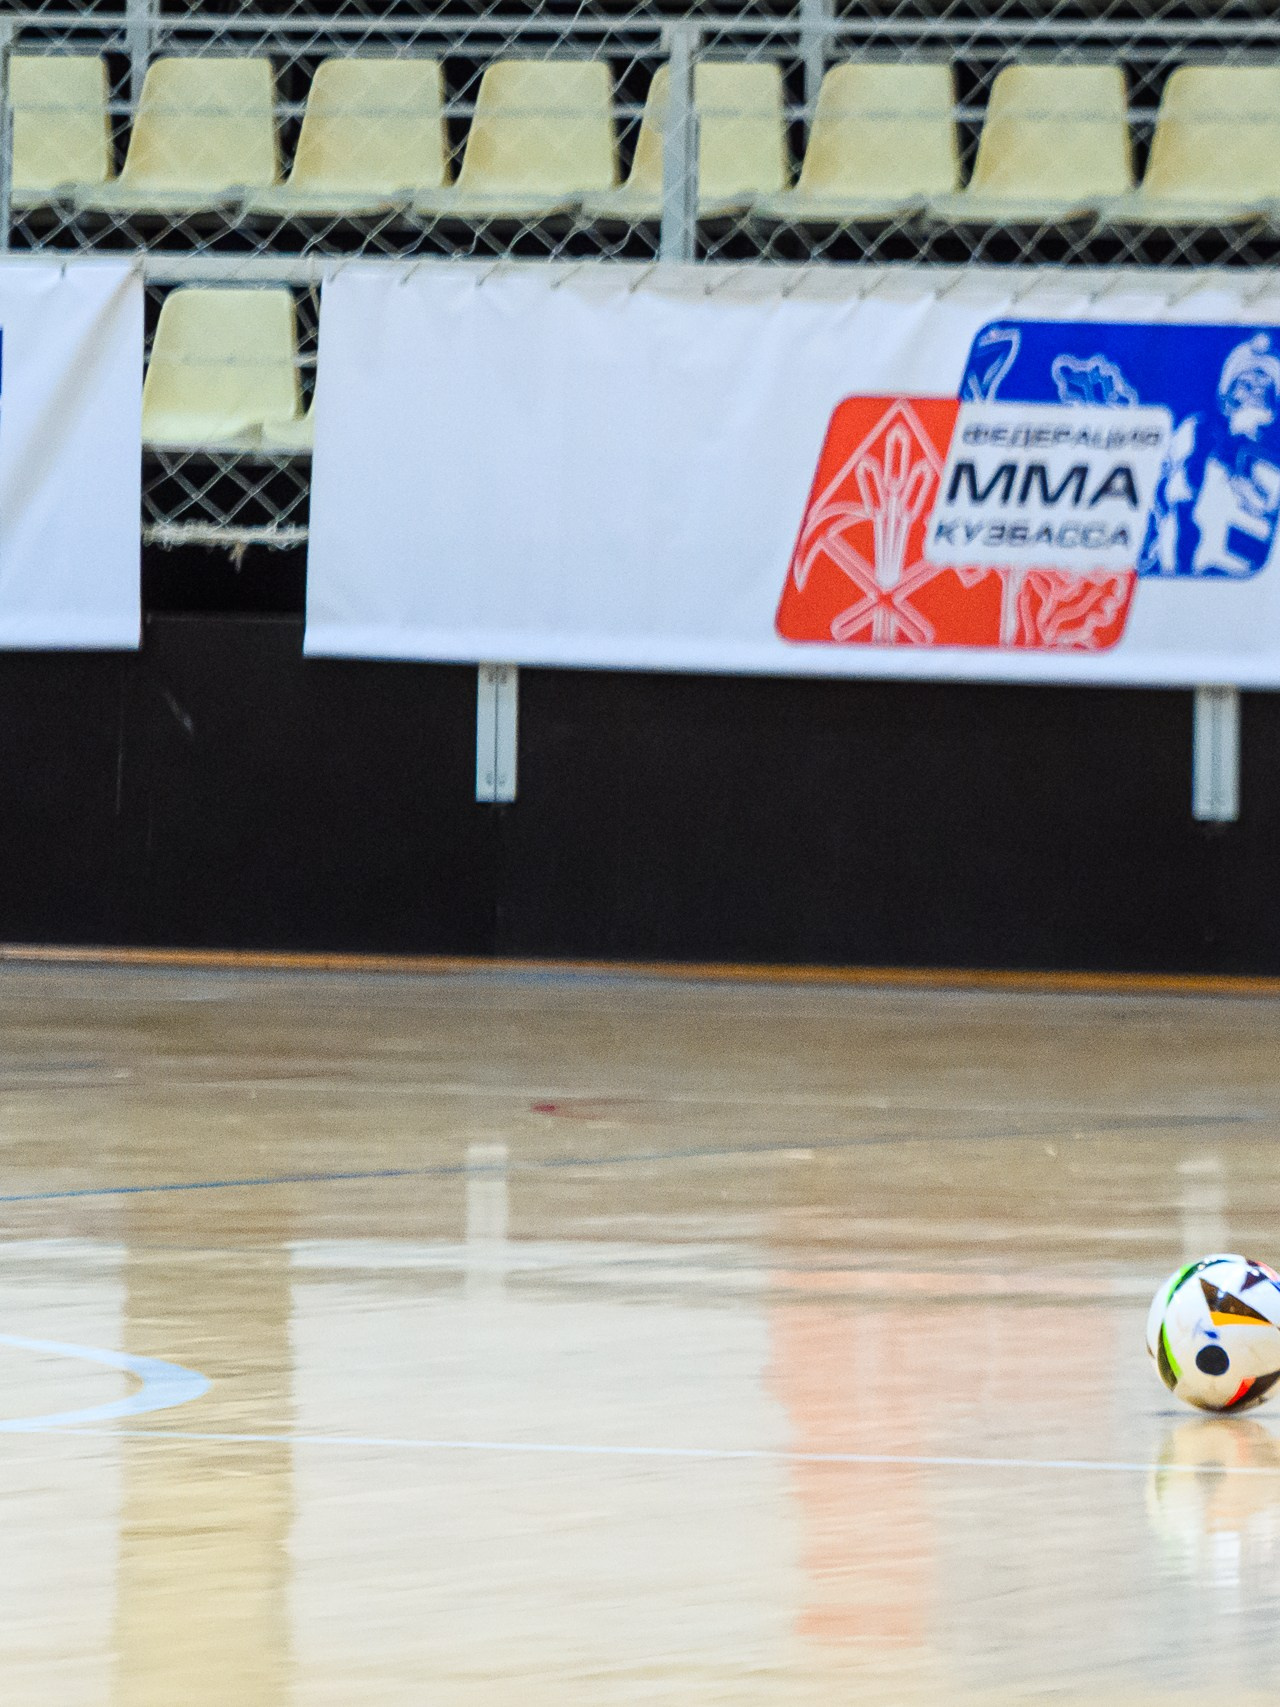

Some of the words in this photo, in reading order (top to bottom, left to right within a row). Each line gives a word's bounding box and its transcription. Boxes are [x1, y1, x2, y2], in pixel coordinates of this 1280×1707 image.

[963, 424, 1161, 449] ФЕДЕРАЦИЯ
[947, 461, 1139, 506] ММА
[935, 519, 1131, 549] КУЗБАССА
